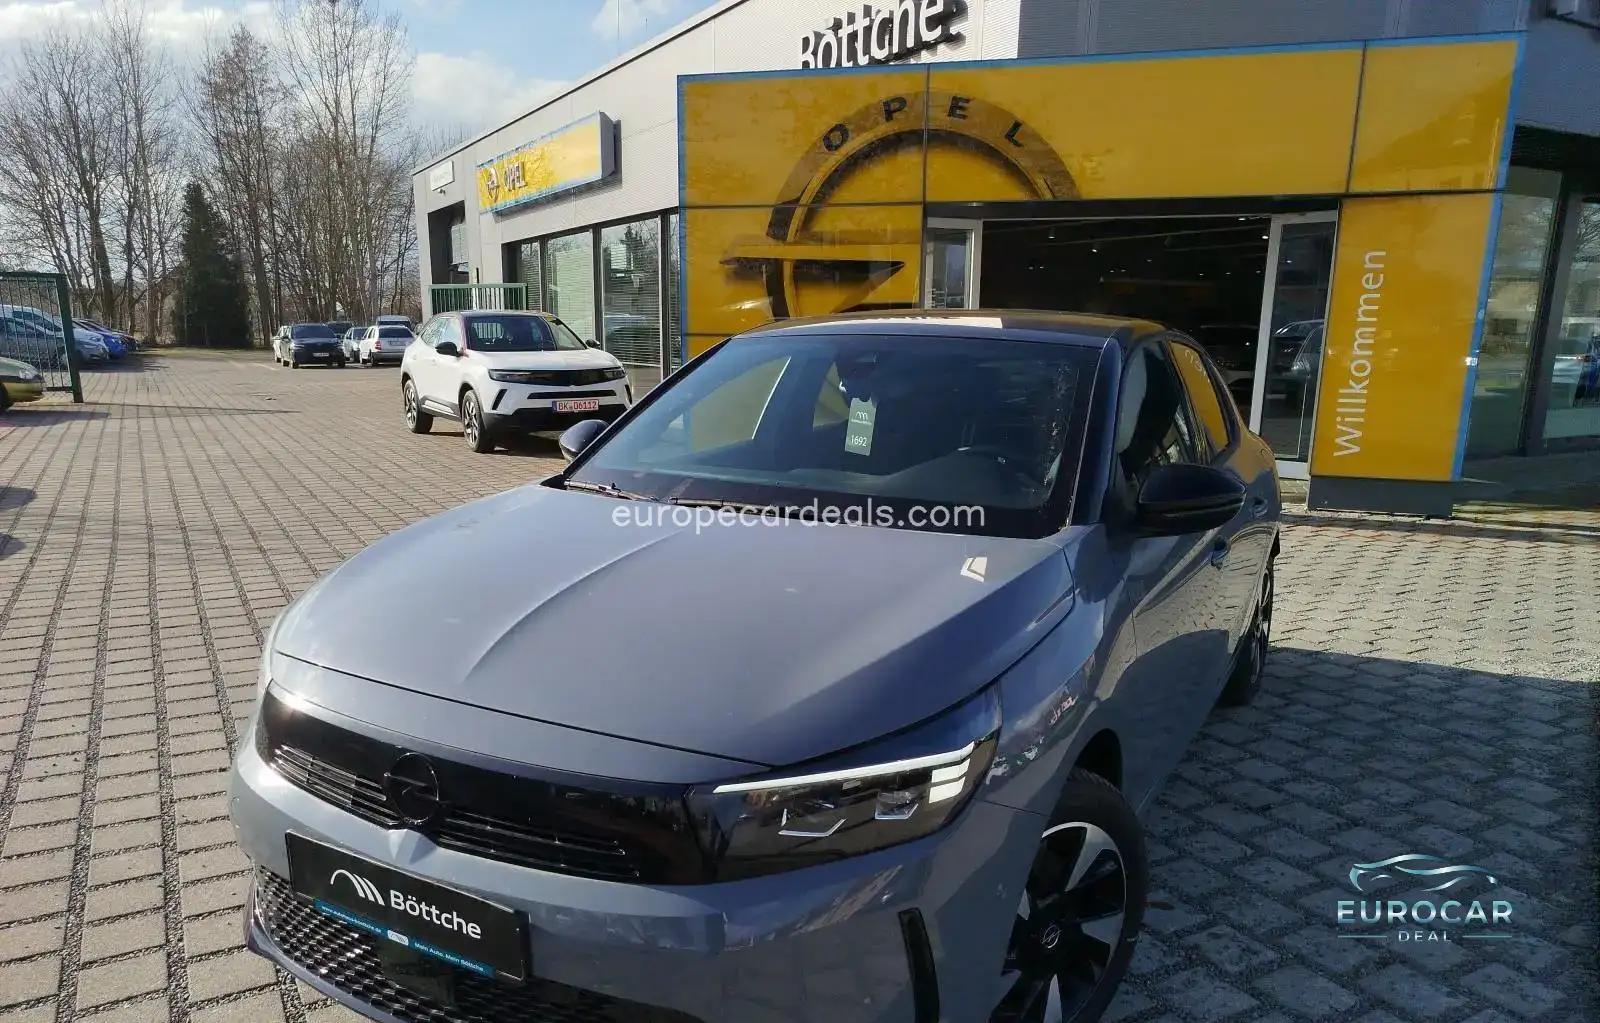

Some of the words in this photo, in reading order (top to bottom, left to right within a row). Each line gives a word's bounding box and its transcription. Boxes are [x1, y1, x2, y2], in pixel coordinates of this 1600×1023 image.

[822, 95, 1025, 152] OPEL
[503, 161, 527, 191] OPEL
[1333, 249, 1387, 457] Willkommen
[851, 434, 868, 447] 1692
[390, 890, 482, 939] Böttche
